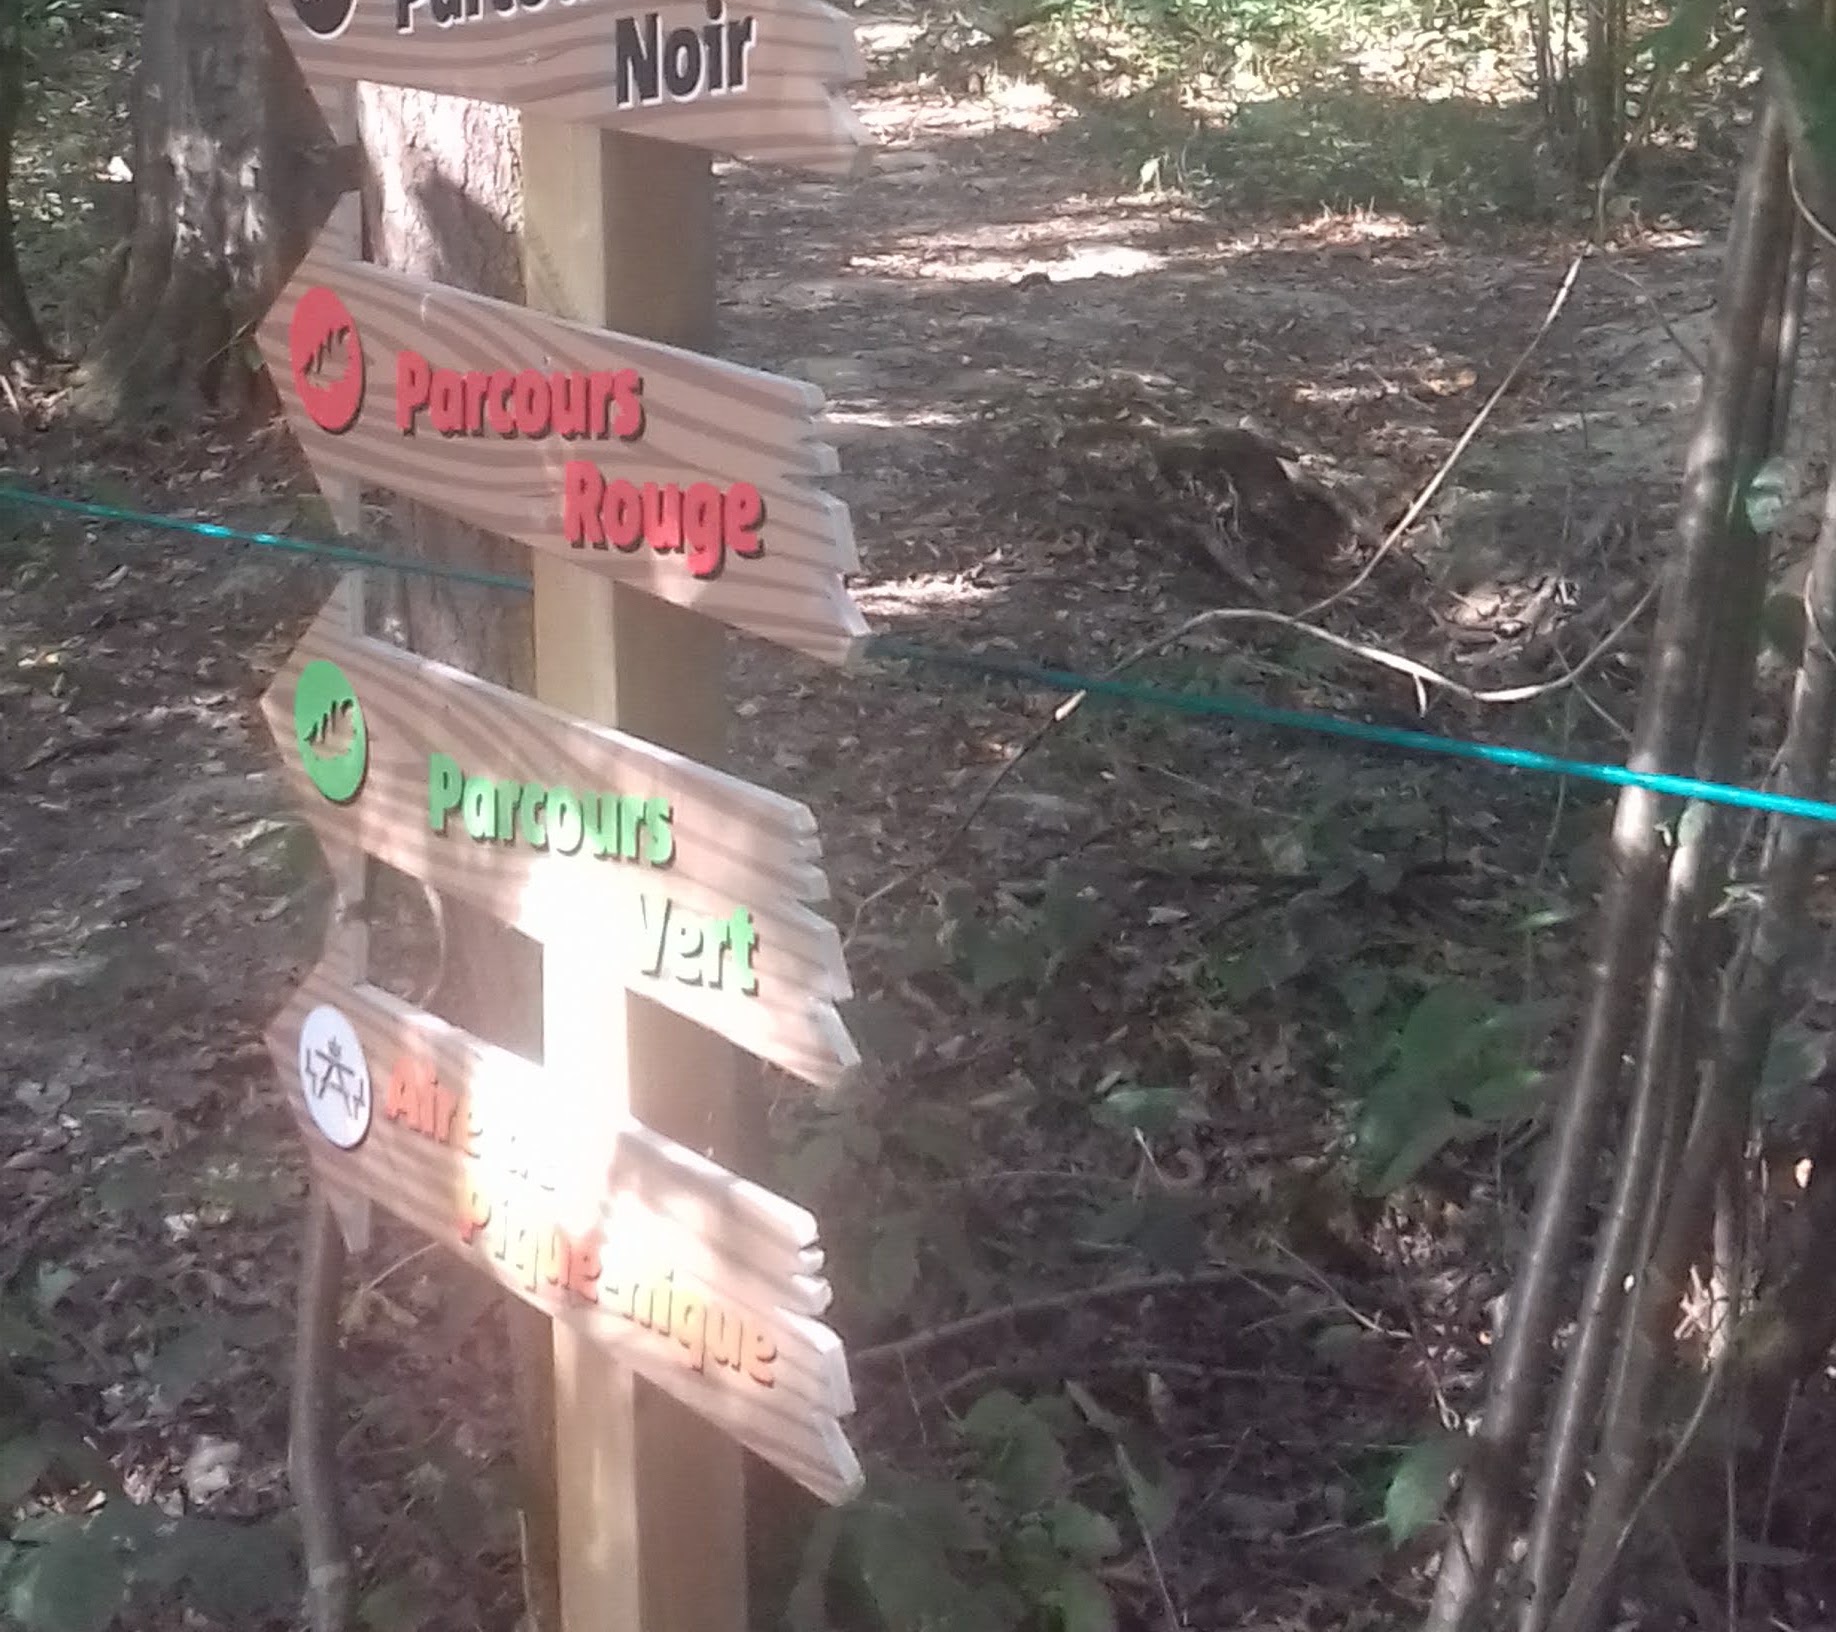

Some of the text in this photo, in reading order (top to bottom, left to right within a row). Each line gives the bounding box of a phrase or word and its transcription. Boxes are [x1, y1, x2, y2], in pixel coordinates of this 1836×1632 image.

[396, 350, 645, 441] Parcours
[563, 460, 767, 579] Rouge
[428, 752, 675, 866] Parcours
[639, 893, 760, 996] Vert
